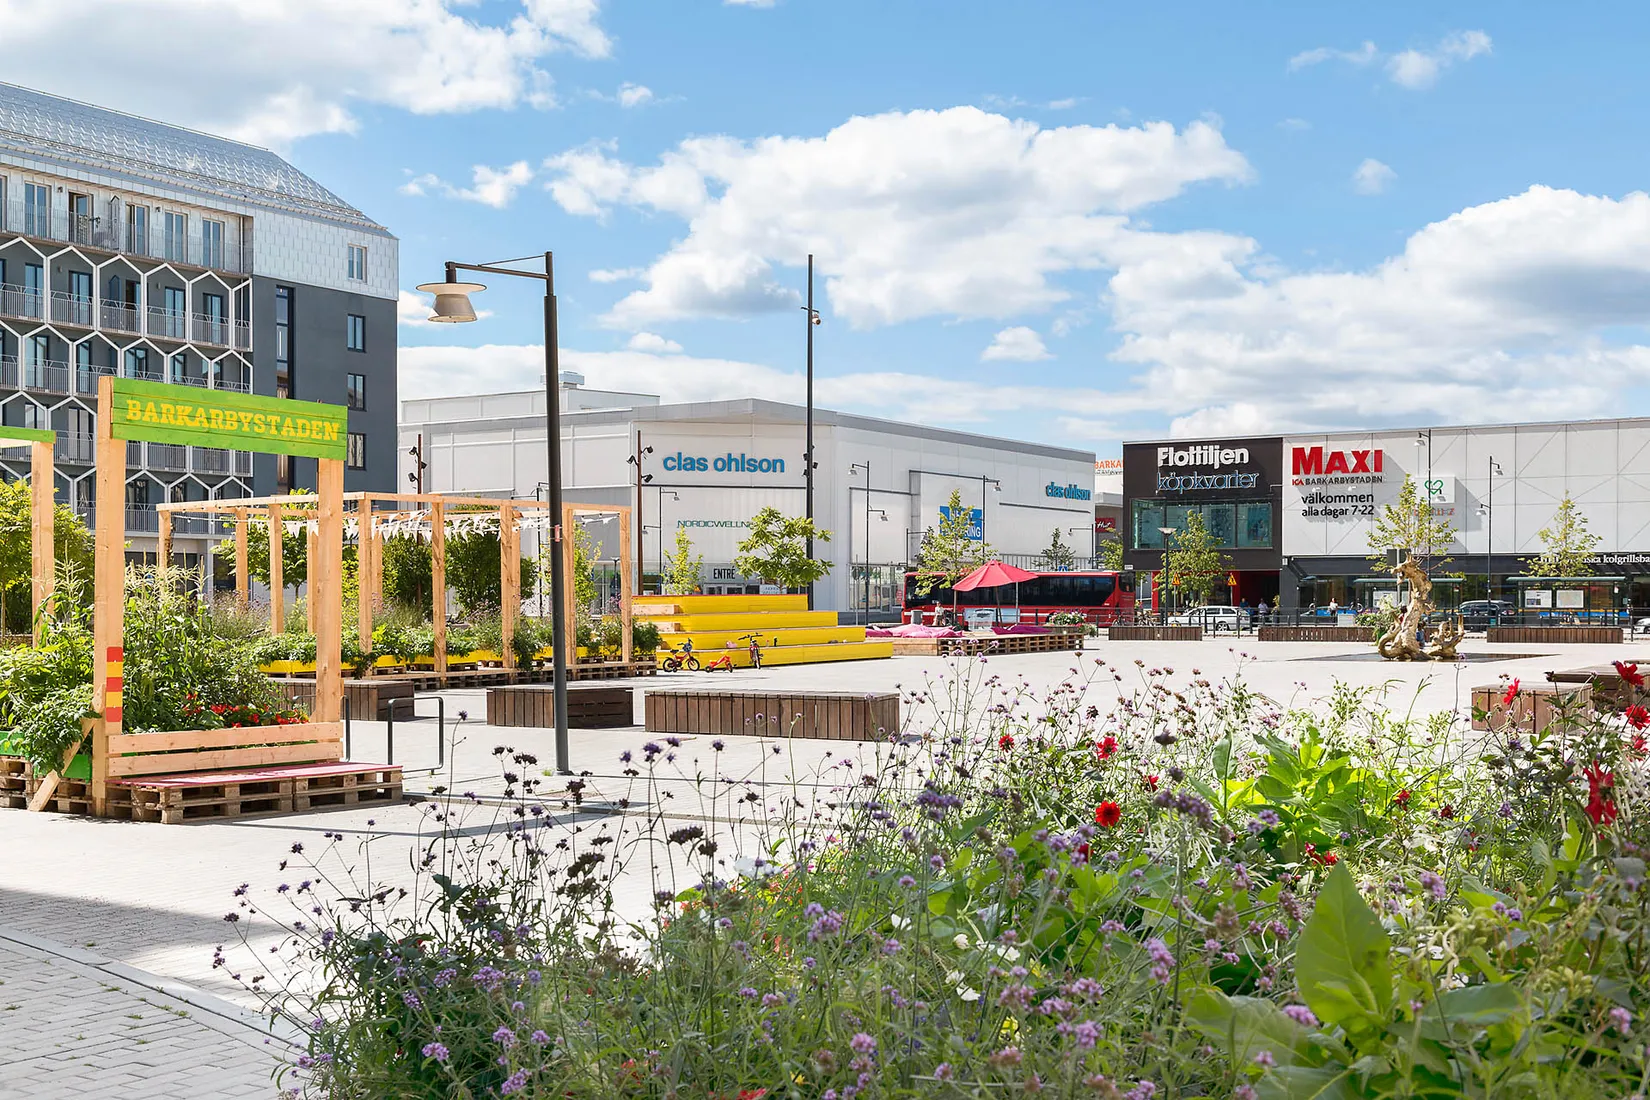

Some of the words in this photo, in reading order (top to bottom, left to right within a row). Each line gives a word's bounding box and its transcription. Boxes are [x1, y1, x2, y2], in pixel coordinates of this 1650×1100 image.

[126, 399, 340, 441] BARKARBYSTADEN
[663, 451, 709, 472] clas
[713, 453, 785, 473] ohlson
[1157, 445, 1249, 470] Flottiljen
[1292, 446, 1383, 476] MAXI
[1046, 481, 1064, 498] clas
[1064, 484, 1091, 501] ohlson
[1157, 470, 1259, 494] köpkvarter
[1292, 478, 1304, 486] ICA
[1305, 476, 1383, 486] BARKARBYSTADEN
[1301, 492, 1374, 504] välkommen
[1302, 506, 1319, 517] alla
[1320, 506, 1349, 519] dagar
[1351, 505, 1374, 516] 7-22
[713, 566, 736, 580] ENTRÉ
